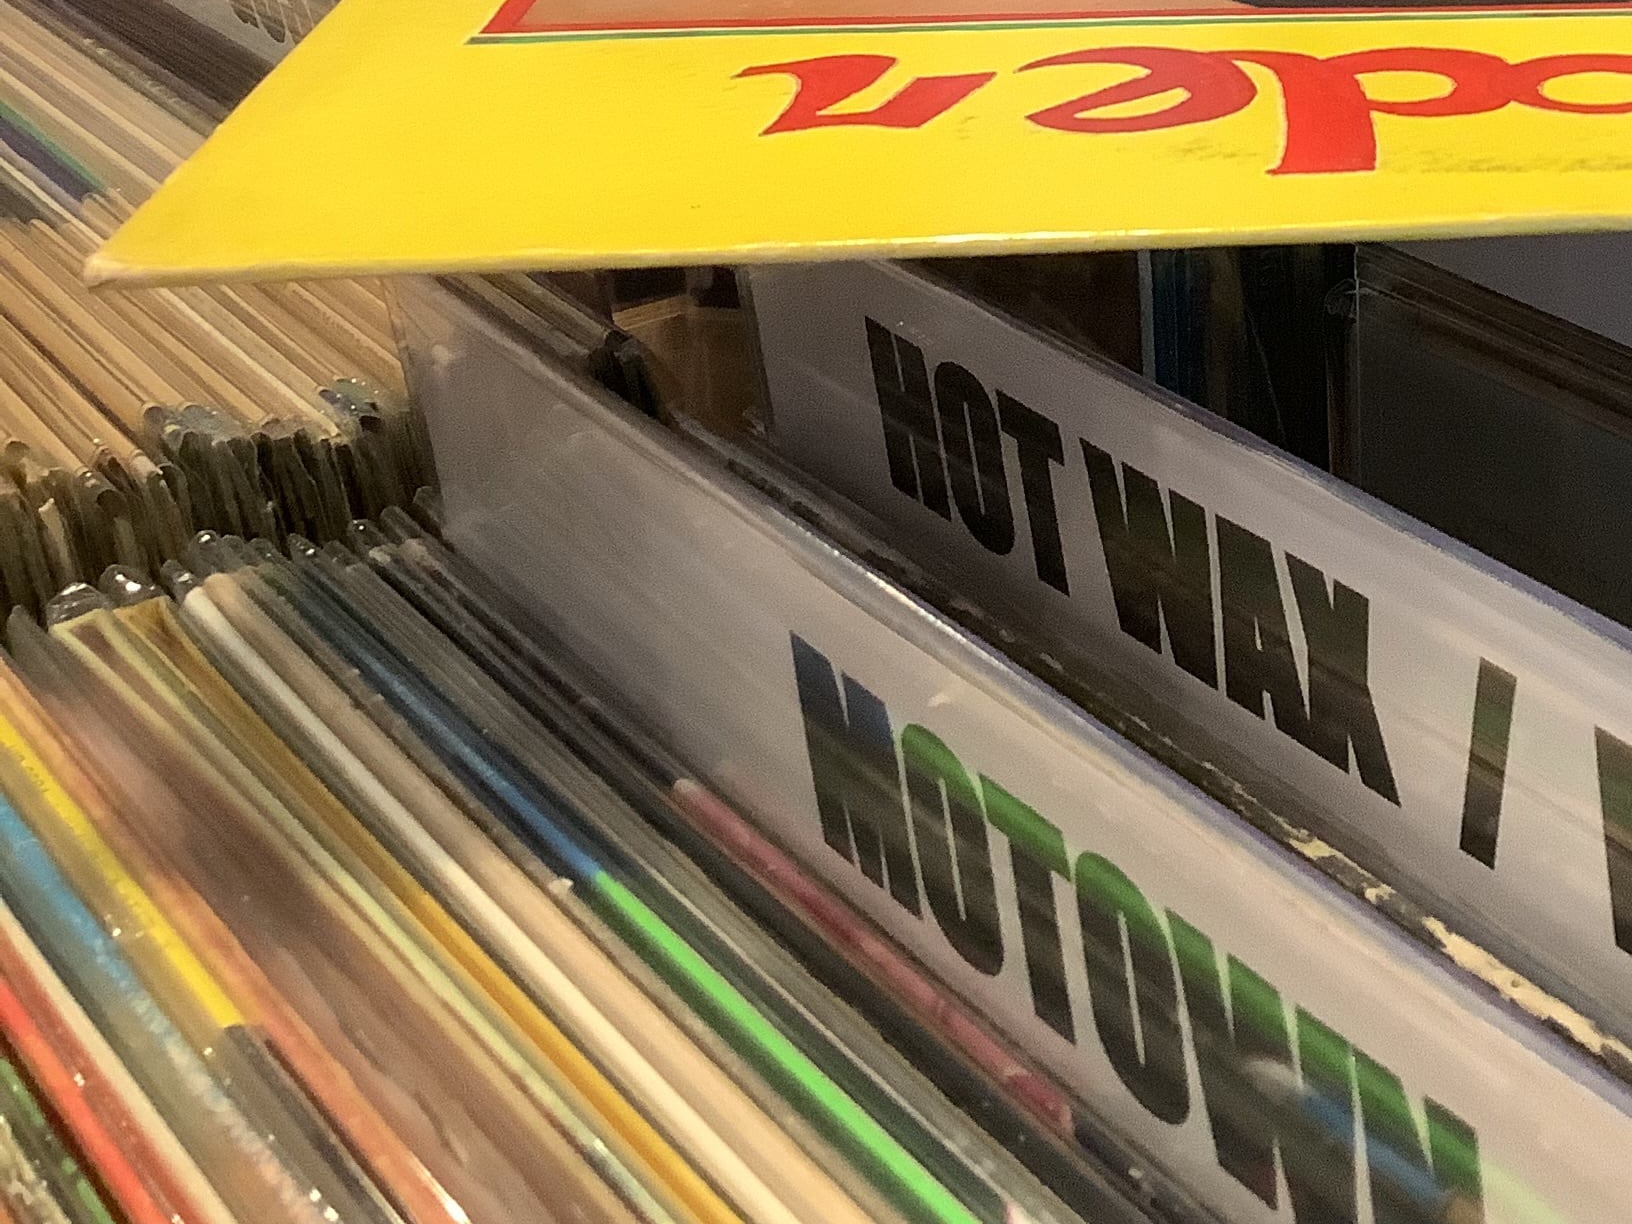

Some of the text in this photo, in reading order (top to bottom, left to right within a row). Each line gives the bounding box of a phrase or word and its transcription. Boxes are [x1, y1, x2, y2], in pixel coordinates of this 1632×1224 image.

[865, 315, 1070, 597] HOT
[1079, 436, 1401, 808] WAX
[1460, 656, 1517, 870] /
